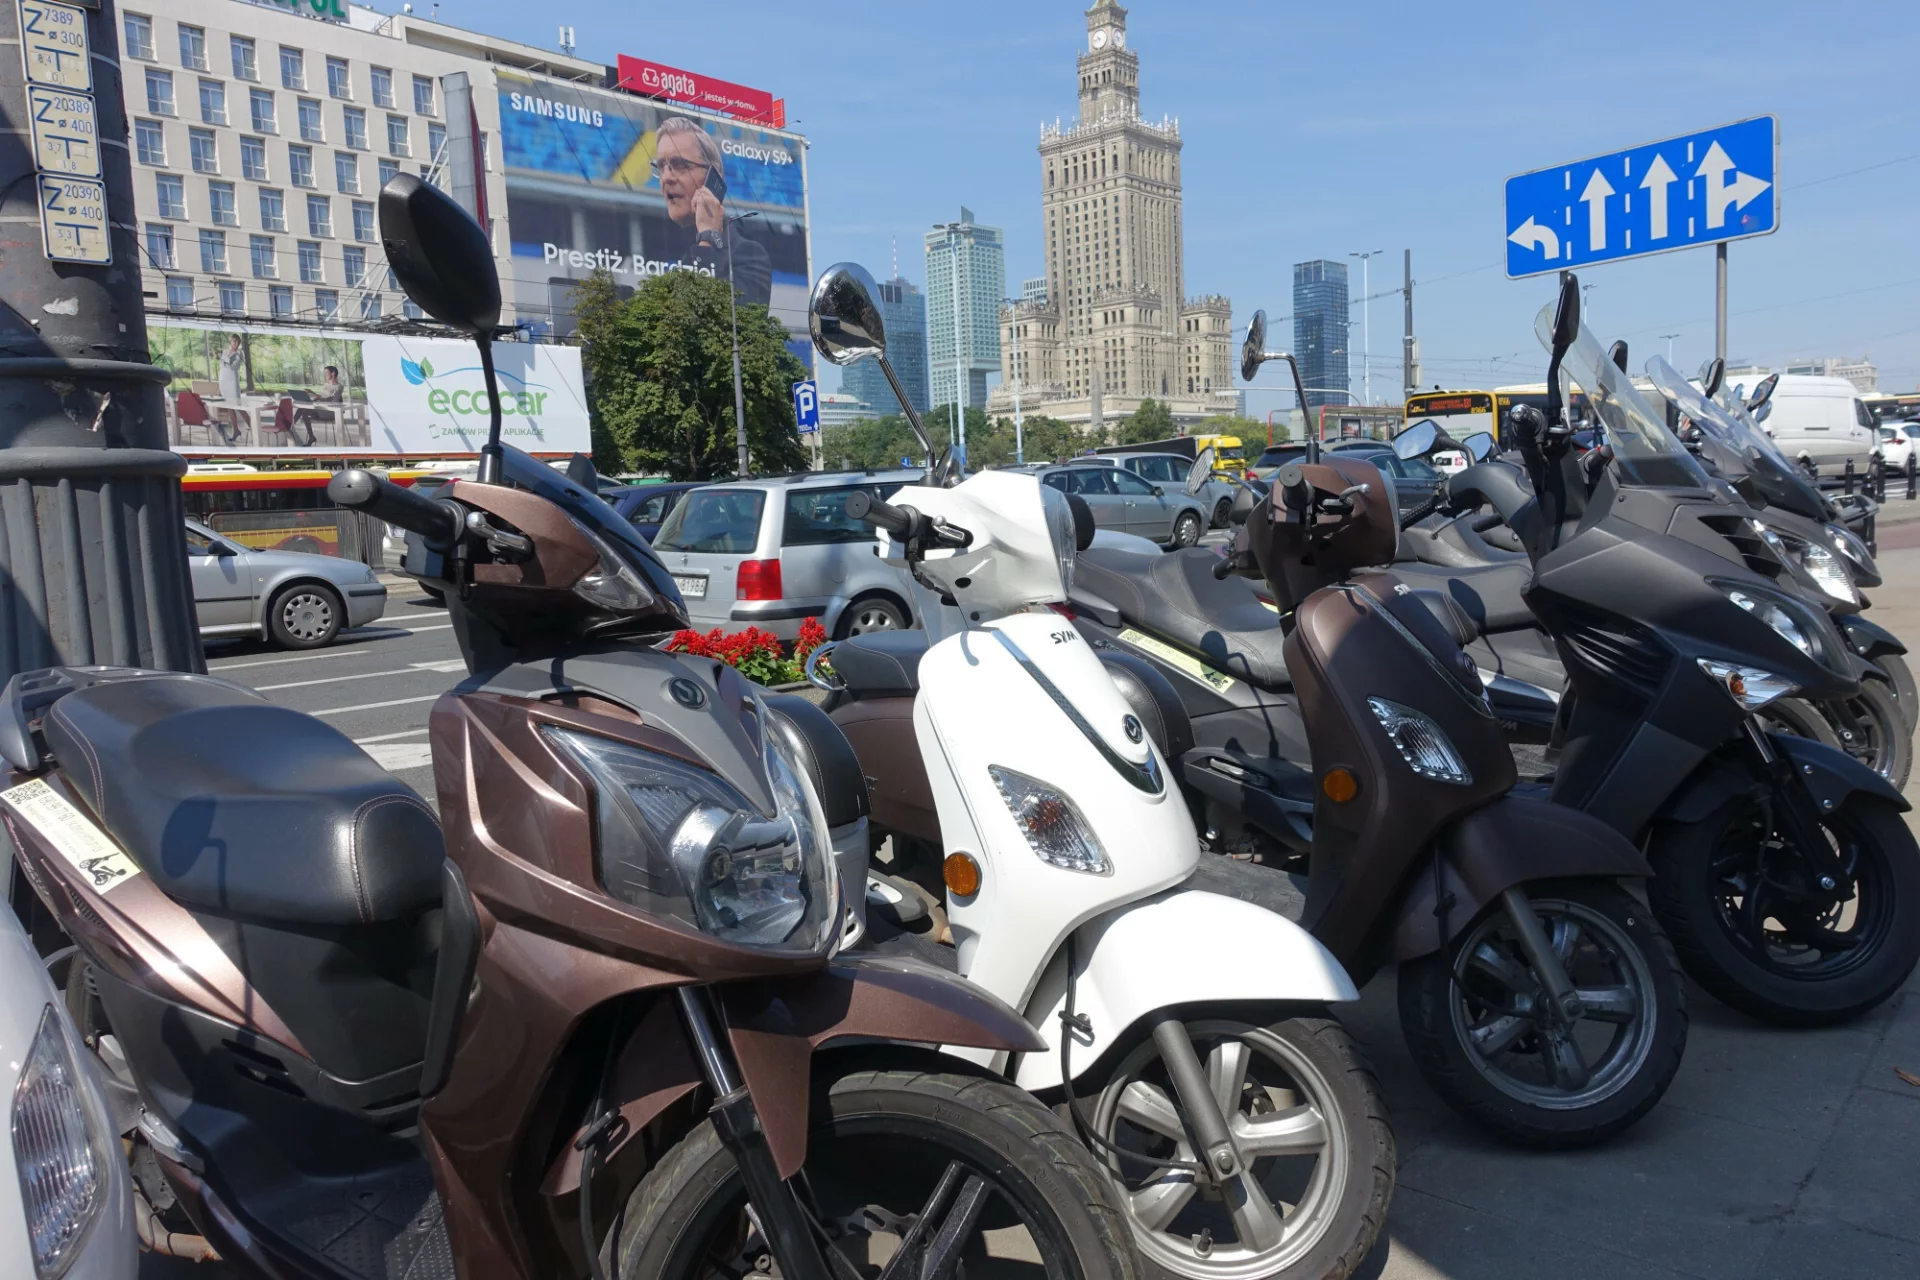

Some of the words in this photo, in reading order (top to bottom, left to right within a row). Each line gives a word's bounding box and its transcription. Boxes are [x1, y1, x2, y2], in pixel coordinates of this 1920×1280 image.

[24, 7, 45, 35] Z
[44, 7, 73, 25] 7389
[61, 30, 84, 48] 300
[661, 72, 695, 97] agata
[34, 97, 54, 124] Z
[54, 96, 90, 114] 20389
[510, 91, 603, 128] SAMSUNG
[704, 91, 726, 105] jesteś
[71, 119, 93, 135] 400
[721, 140, 770, 166] Galaxy
[44, 185, 64, 211] Z
[64, 184, 100, 202] 20390
[80, 206, 103, 221] 400
[428, 388, 548, 416] ecocar
[799, 391, 814, 420] P
[441, 426, 476, 436] ZAMÓW
[1050, 630, 1079, 645] SYM
